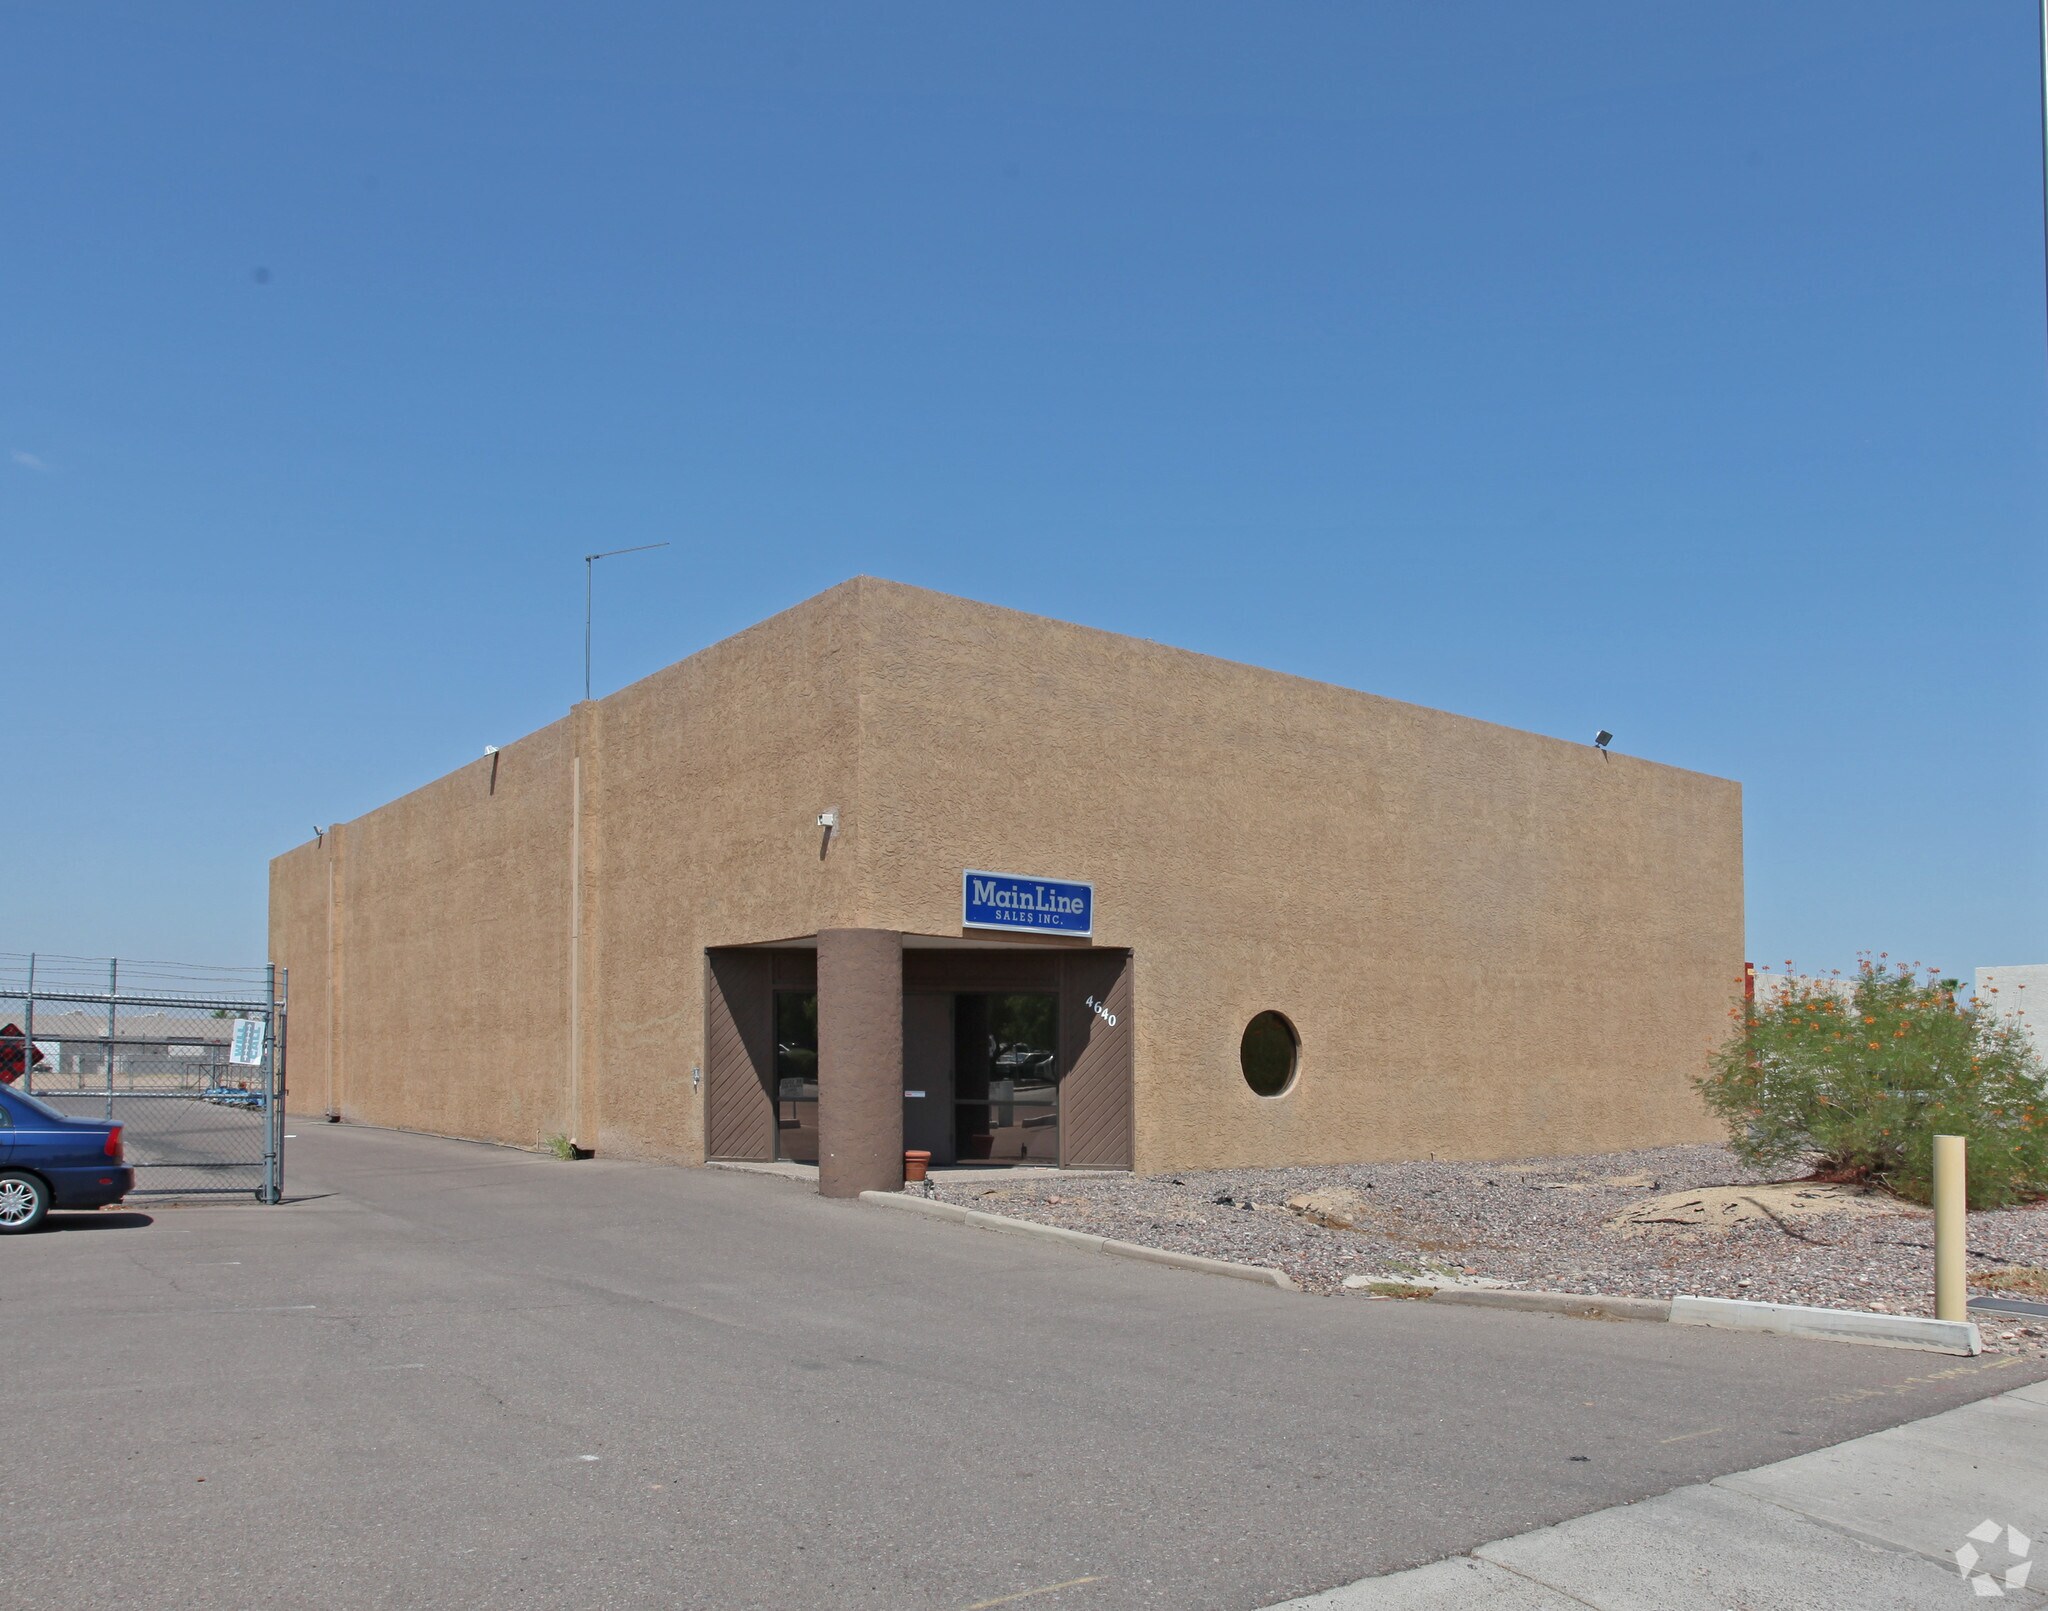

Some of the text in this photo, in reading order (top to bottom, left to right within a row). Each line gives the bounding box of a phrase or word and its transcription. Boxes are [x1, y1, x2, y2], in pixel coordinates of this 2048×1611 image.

[972, 880, 1084, 914] MainLine
[995, 910, 1063, 925] SALES INC.
[1085, 995, 1116, 1027] 4640
